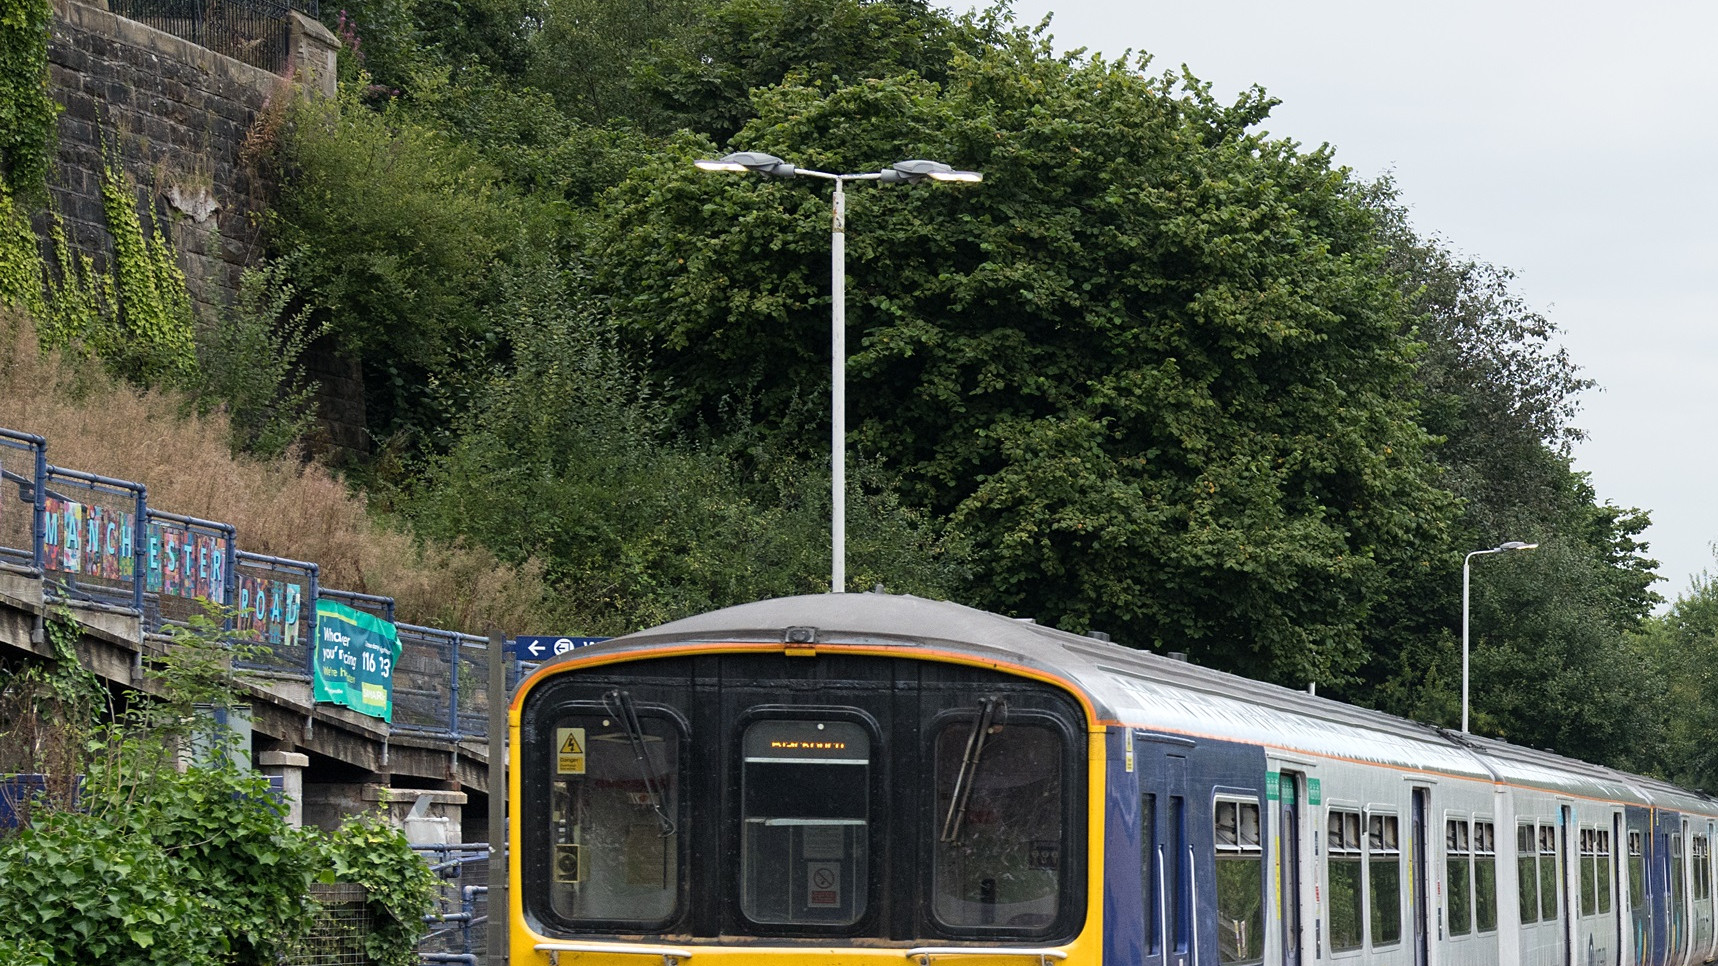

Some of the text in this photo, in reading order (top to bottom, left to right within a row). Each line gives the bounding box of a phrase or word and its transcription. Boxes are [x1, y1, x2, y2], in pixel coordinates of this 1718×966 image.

[45, 513, 298, 625] MANCHESTER ROAD
[362, 651, 376, 672] 116
